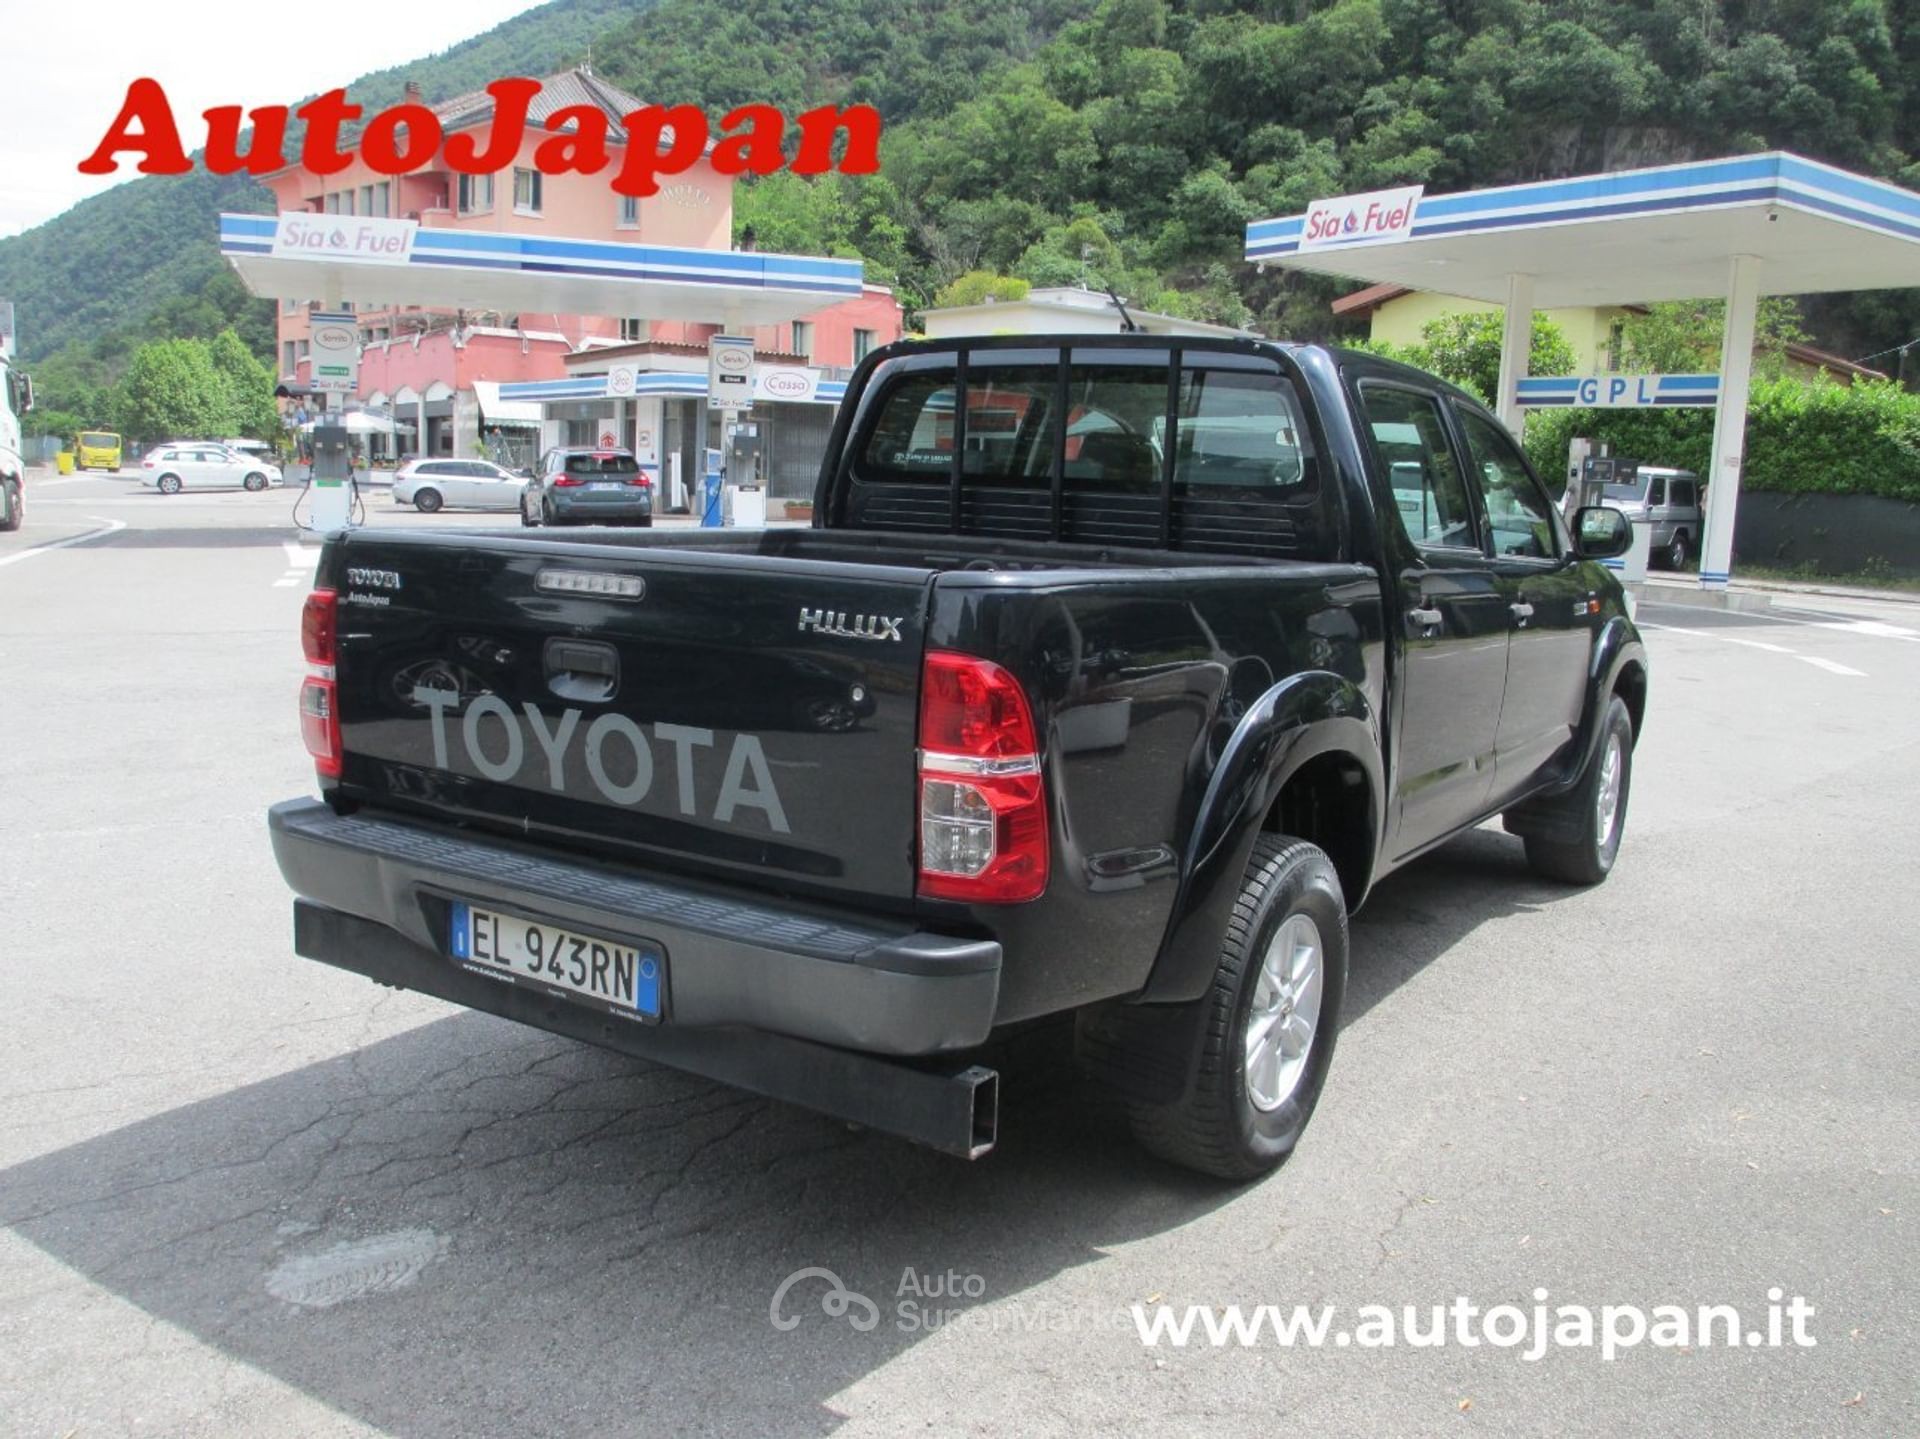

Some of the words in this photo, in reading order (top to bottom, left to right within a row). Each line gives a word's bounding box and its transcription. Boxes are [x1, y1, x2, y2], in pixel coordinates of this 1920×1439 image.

[1307, 210, 1341, 239] Sia
[1364, 197, 1413, 232] Fuel
[283, 221, 326, 248] Sia
[355, 226, 410, 253] Fuel
[769, 376, 805, 390] Cassa
[347, 568, 401, 589] TOYOTA
[798, 607, 903, 641] HILUX
[413, 686, 792, 834] TOYOTA
[473, 912, 511, 966] EL
[525, 926, 634, 1001] 943RN
